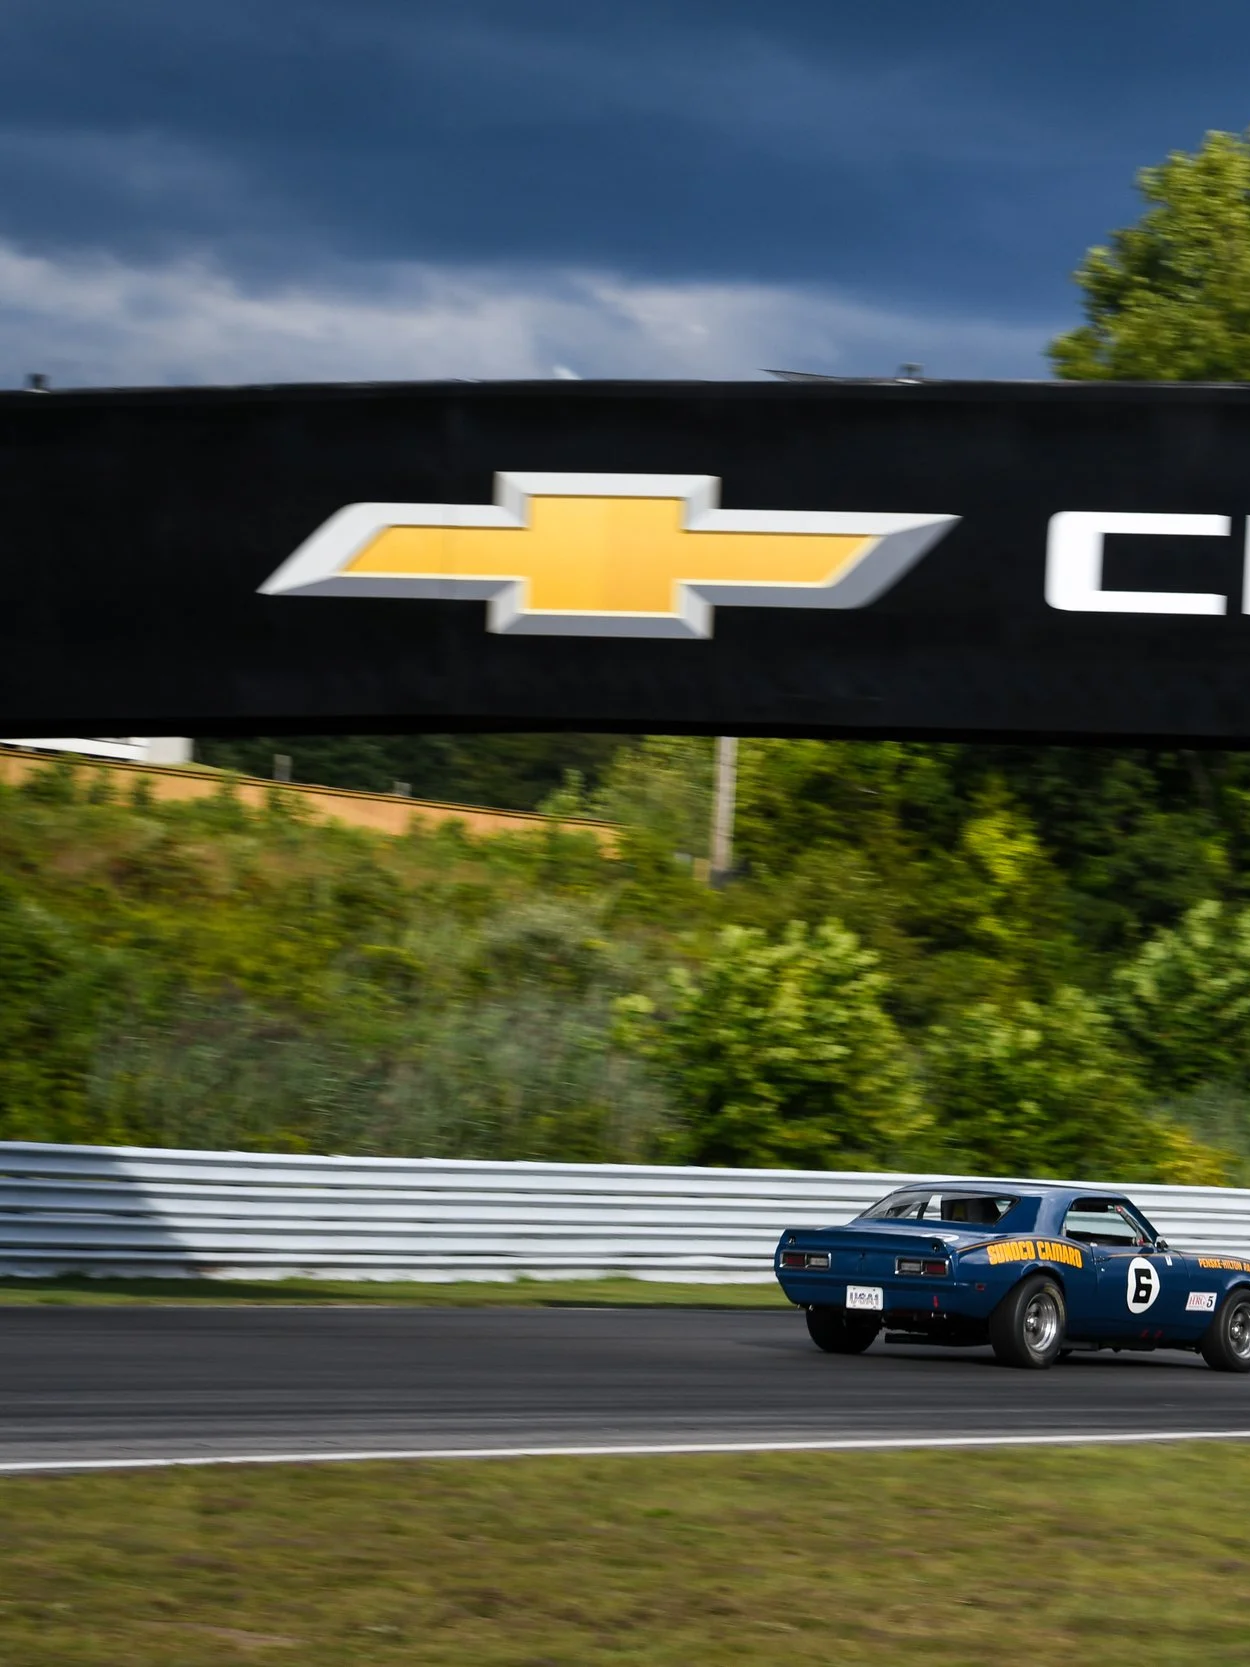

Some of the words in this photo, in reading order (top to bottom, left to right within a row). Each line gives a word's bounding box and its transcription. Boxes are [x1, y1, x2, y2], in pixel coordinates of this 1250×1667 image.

[987, 1241, 1036, 1265] SUNOCO
[1037, 1241, 1083, 1269] CAMARO
[1198, 1258, 1243, 1271] PENSKE-HILTON
[1132, 1268, 1152, 1304] 6
[1206, 1295, 1214, 1308] 5
